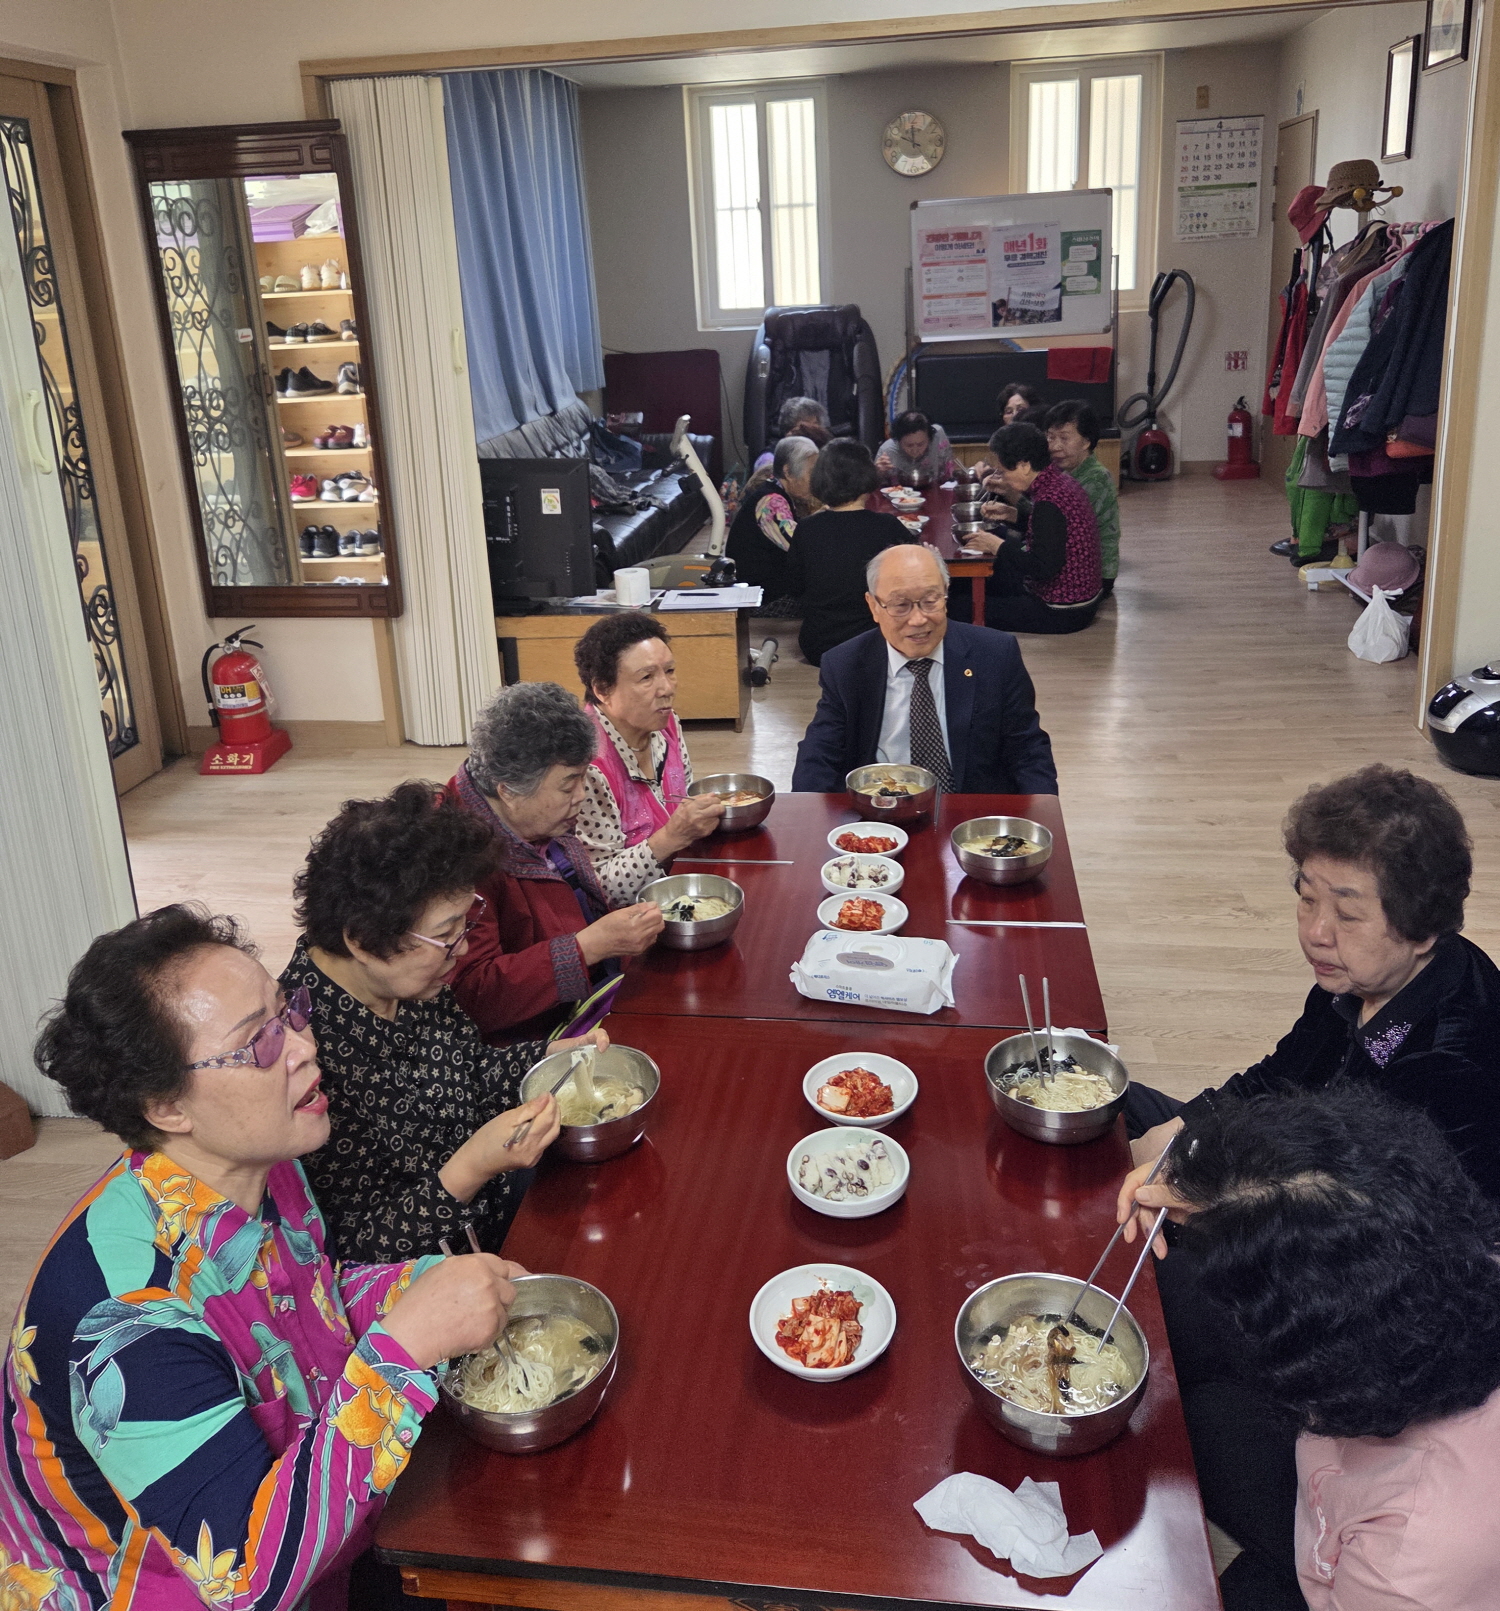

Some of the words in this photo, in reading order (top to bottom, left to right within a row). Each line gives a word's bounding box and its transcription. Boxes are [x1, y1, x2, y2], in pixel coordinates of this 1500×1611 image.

[1217, 121, 1223, 129] 4
[1004, 239, 1026, 253] 매년
[210, 753, 254, 766] 소화기
